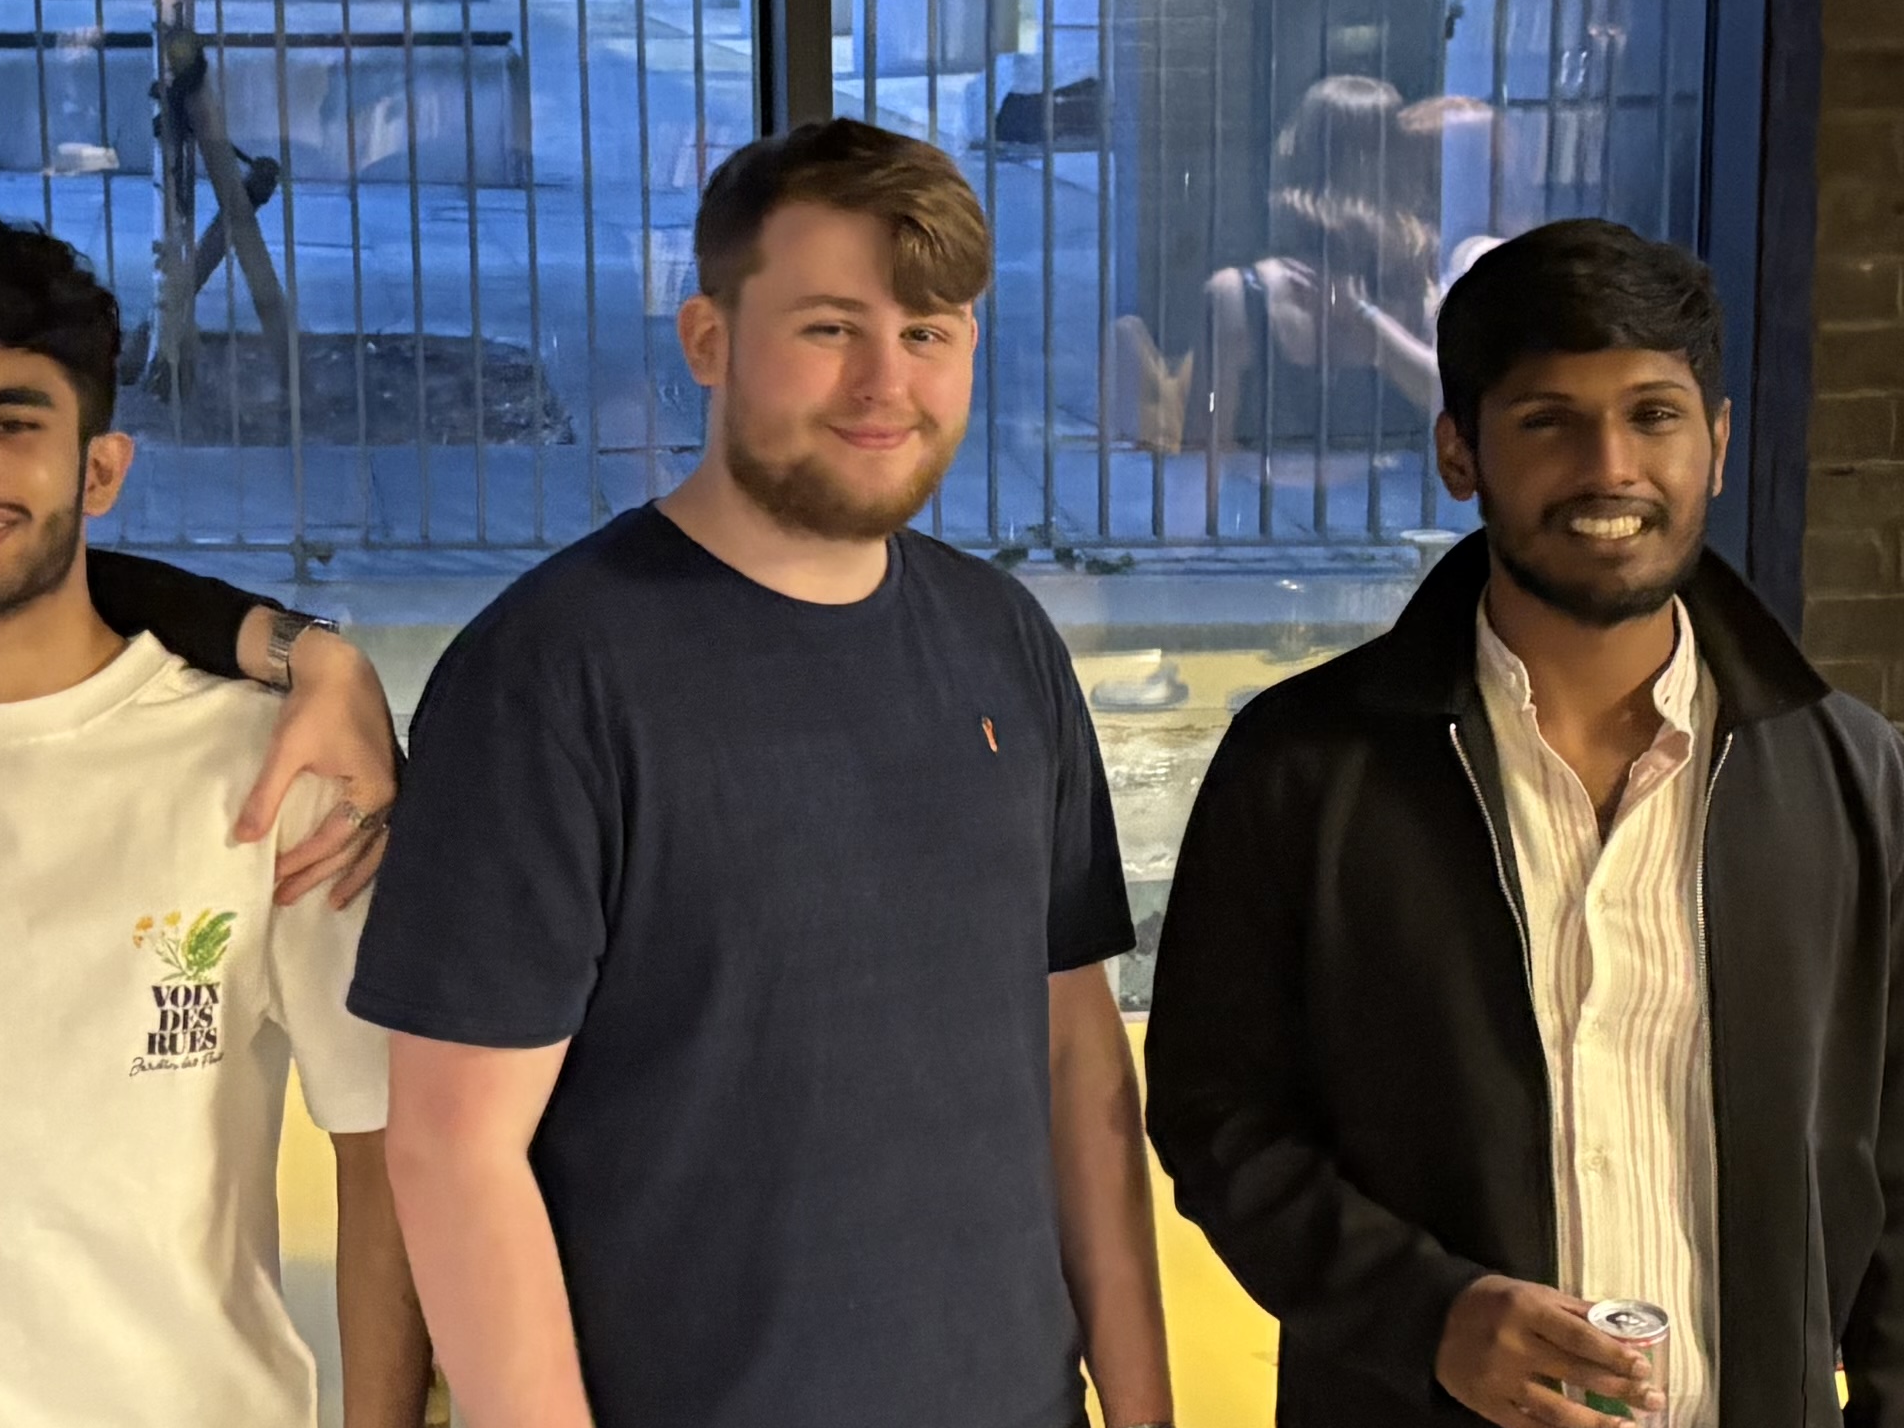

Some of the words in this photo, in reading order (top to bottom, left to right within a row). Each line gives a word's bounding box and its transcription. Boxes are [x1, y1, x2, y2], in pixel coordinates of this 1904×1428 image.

[152, 981, 221, 1008] VOIX
[159, 1006, 213, 1031] DES
[147, 1028, 217, 1055] RUES
